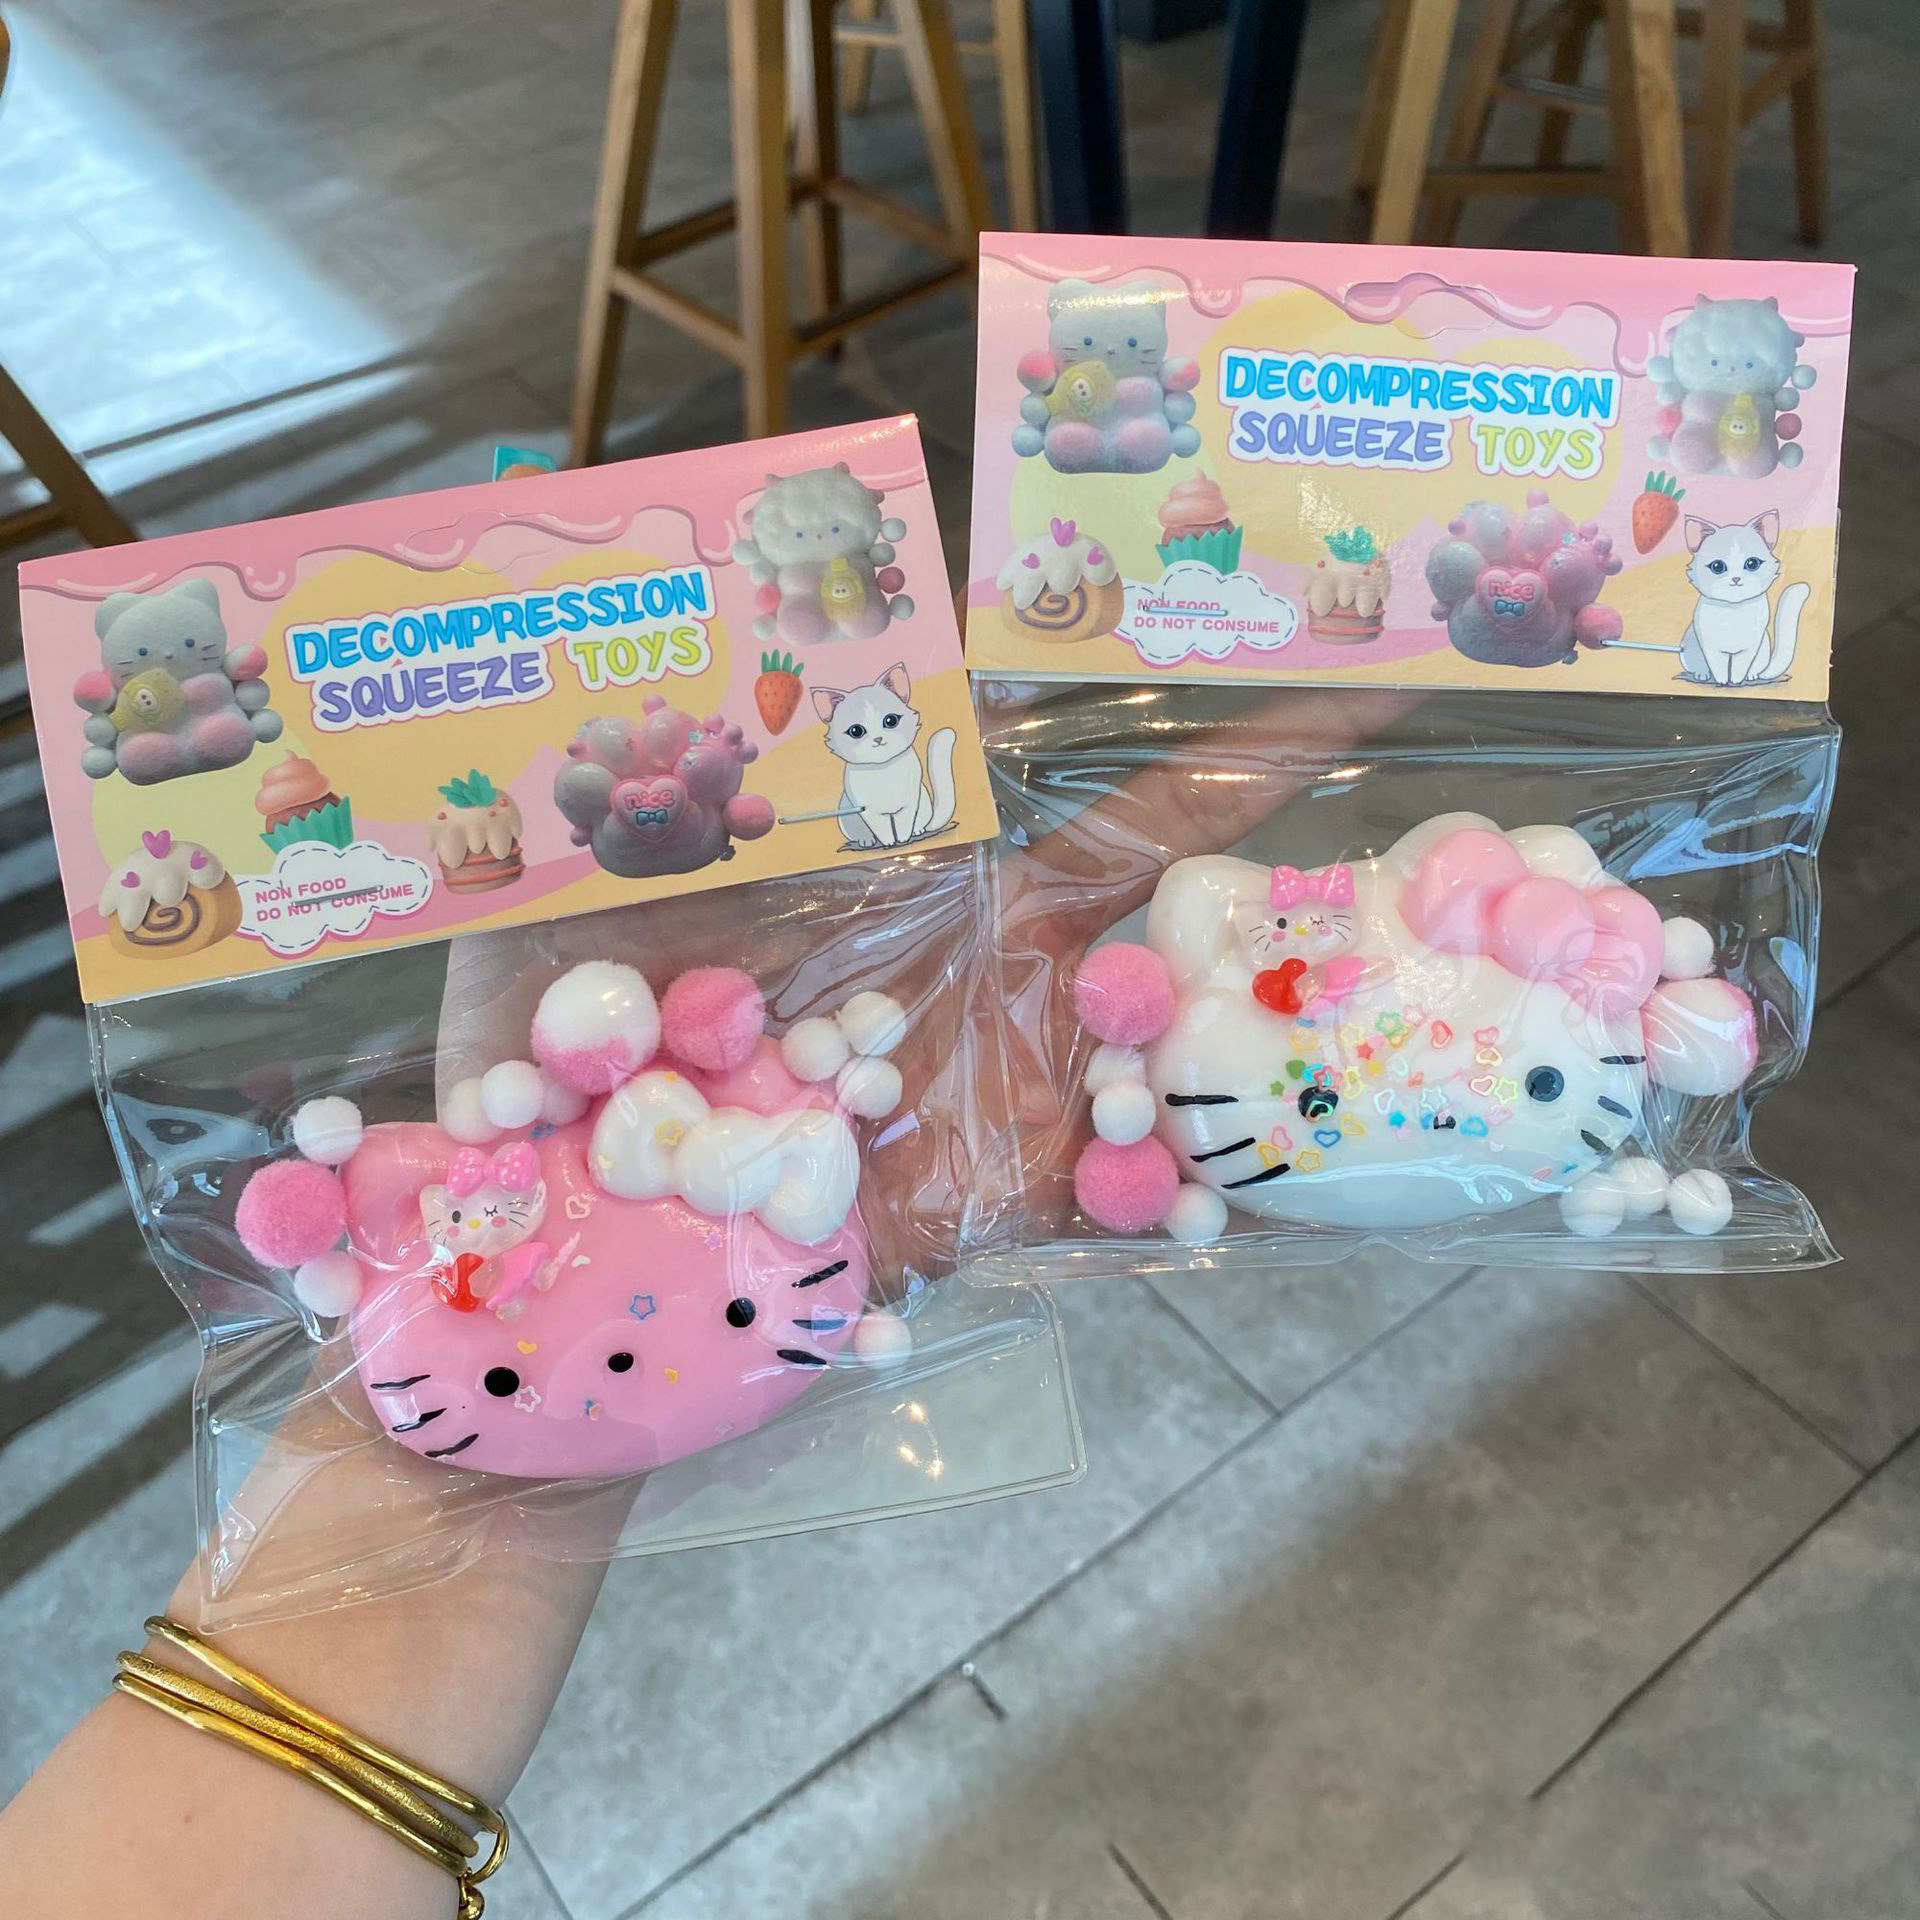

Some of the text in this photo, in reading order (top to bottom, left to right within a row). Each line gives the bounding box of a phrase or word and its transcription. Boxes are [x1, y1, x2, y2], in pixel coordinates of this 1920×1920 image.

[1226, 355, 1613, 419] DECOMPRESSION
[1236, 410, 1595, 471] SQUEEZE TOYS
[1488, 580, 1534, 602] nice
[292, 571, 707, 674] DECOMPRESSION
[1134, 616, 1280, 633] DO NOT CONSUME
[319, 626, 701, 723] SQUEEZE TOYS
[623, 789, 676, 811] nice
[255, 877, 346, 904] NON FOOD
[256, 884, 414, 922] DO NOT CONSUME
